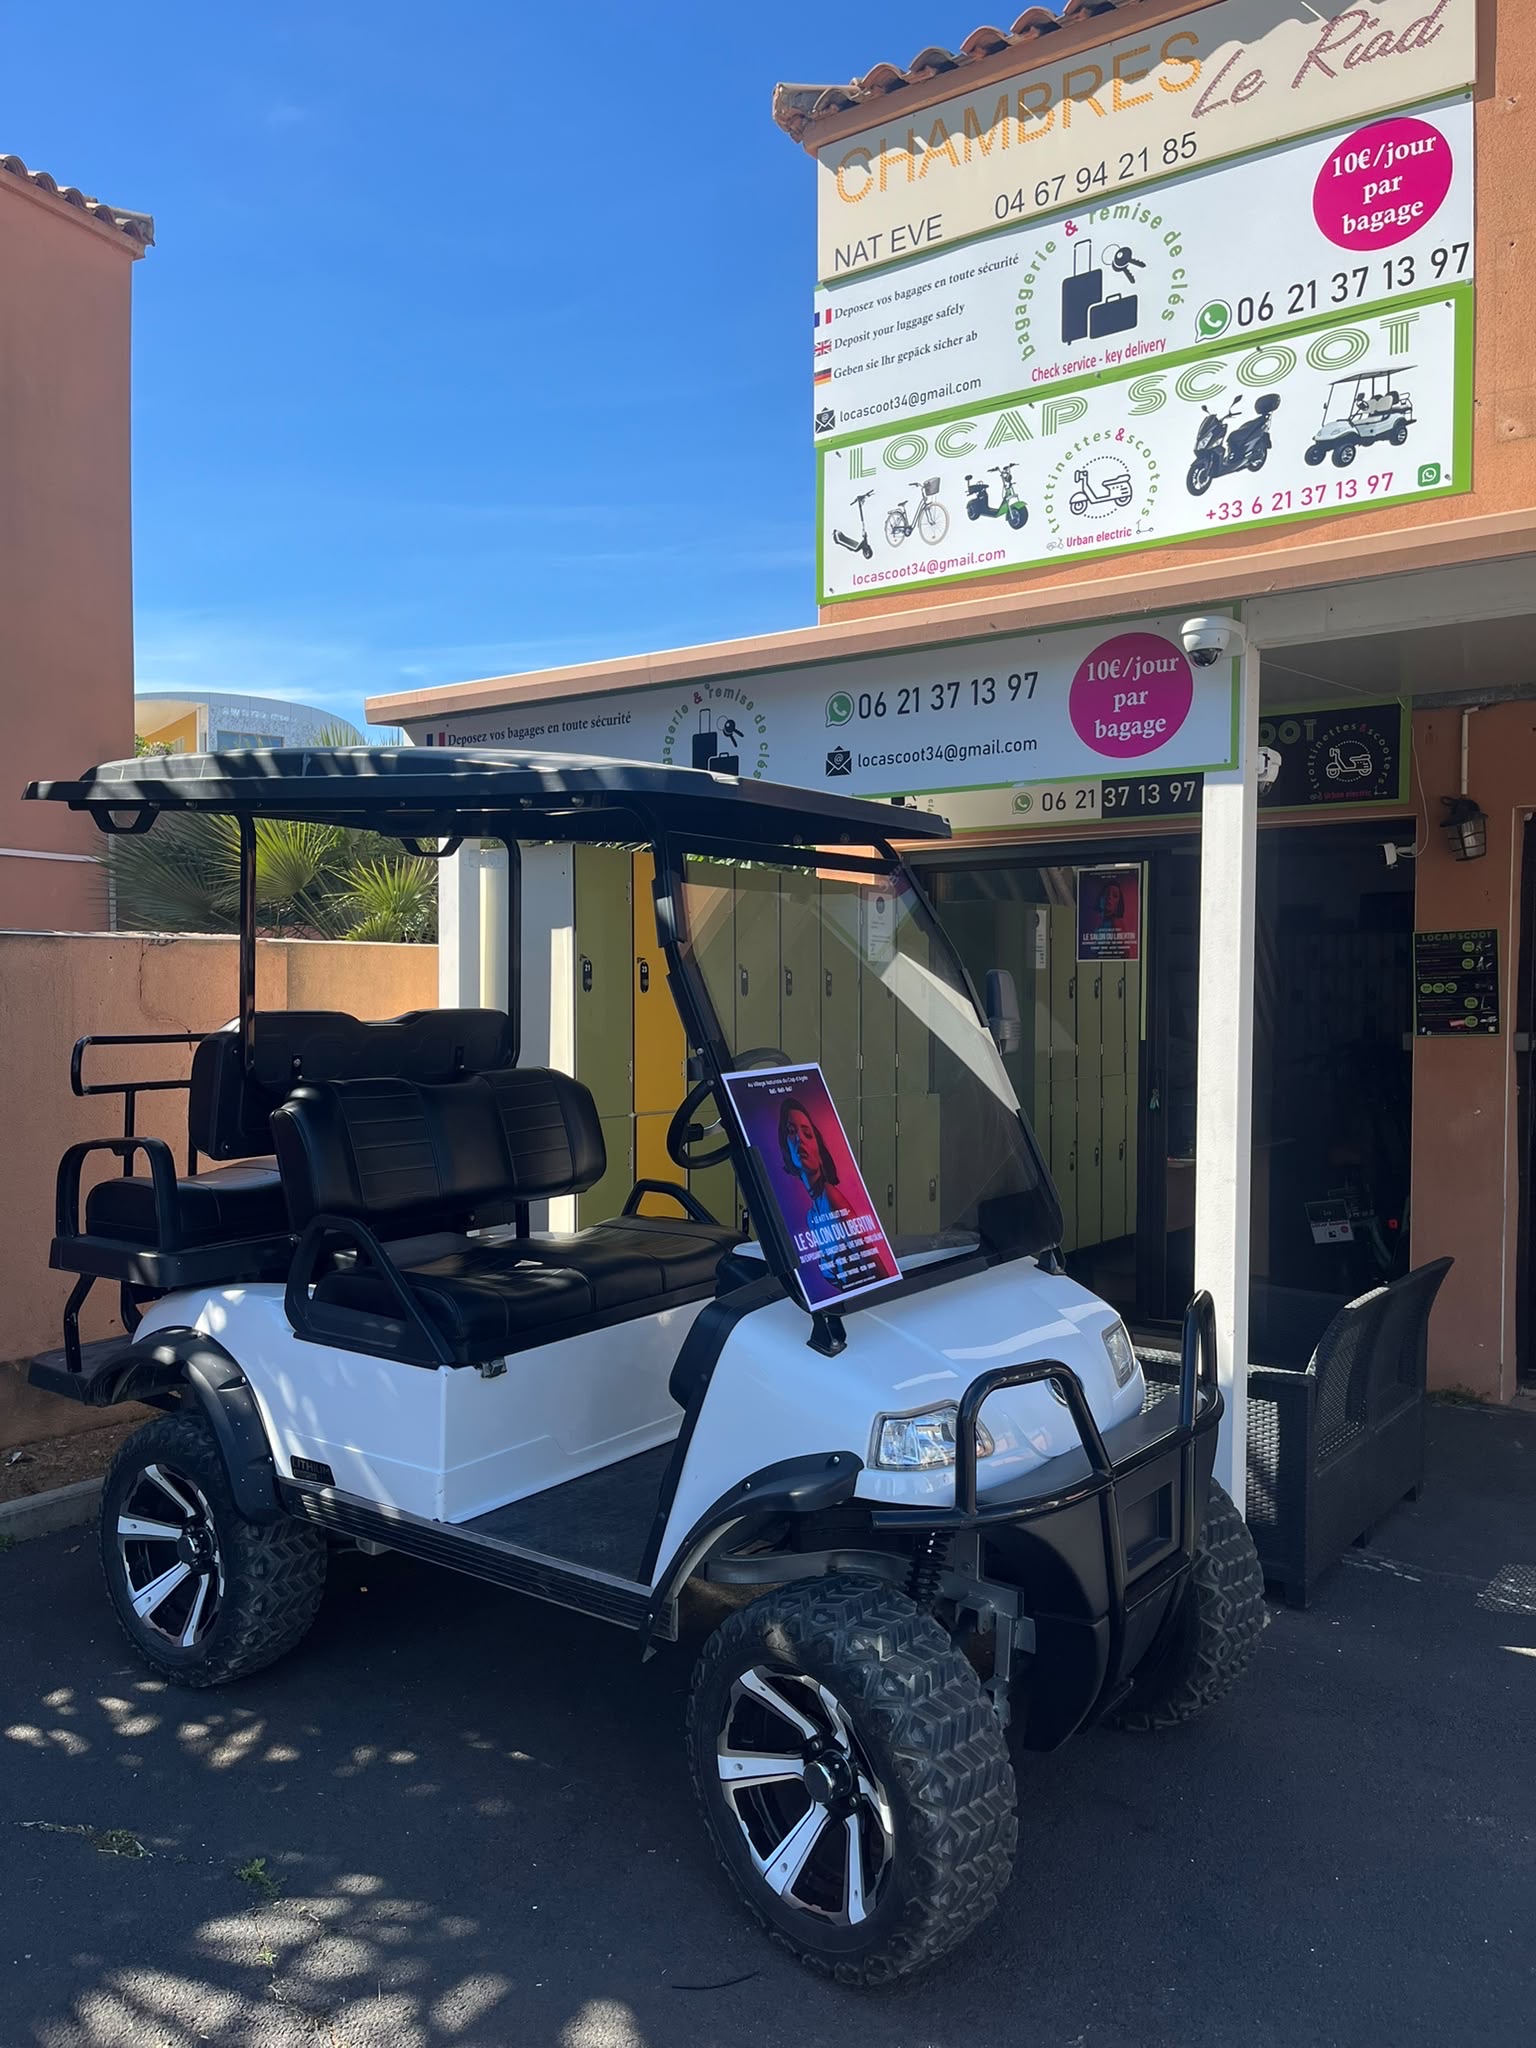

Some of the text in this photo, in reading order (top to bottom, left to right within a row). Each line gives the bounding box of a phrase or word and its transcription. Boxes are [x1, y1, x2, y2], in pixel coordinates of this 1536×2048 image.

[1191, 0, 1449, 119] Le Riad
[834, 31, 1202, 203] CHAMBRES
[994, 131, 1198, 219] 04 67 94 21 85
[1332, 134, 1437, 177] 10€/jour
[1362, 174, 1403, 204] par
[1342, 200, 1424, 235] bagage
[834, 215, 943, 271] NAT EVE
[834, 253, 1020, 320] Deposez vos bagages en toute sécurité
[1015, 203, 1188, 361] bagagerie & remise de clés
[1237, 241, 1470, 326] 06 21 37 13 97
[834, 301, 965, 350] Deposit your luggage safely
[833, 330, 979, 380] Geben sie Ihr gepäck sicher ab
[1031, 361, 1060, 382] Check
[1061, 355, 1097, 375] service
[1105, 347, 1123, 364] key
[1124, 337, 1167, 360] delivery
[839, 376, 982, 422] locascoot34@gmail.com
[850, 312, 1420, 480] LOCAP SCOOT
[1206, 472, 1394, 521] +33 6 21 37 13 97
[1066, 527, 1133, 547] Urban electric
[852, 548, 1006, 586] locascoot34@gmail.com
[1086, 653, 1180, 682] 10€/jour
[858, 671, 1039, 719] 06 21 37 13 97
[1113, 689, 1149, 713] par
[448, 711, 632, 748] Deposez vos bagages en toute sécurité
[662, 687, 770, 779] gagerie & remise de clés
[1094, 716, 1167, 741] bagage
[1259, 719, 1317, 746] OOT
[857, 737, 1038, 768] locascoot34@gmail.com
[1041, 780, 1197, 813] 06 21 37 13 97
[794, 1233, 808, 1252] LE
[806, 1226, 835, 1249] SALON
[832, 1223, 846, 1241] DU
[842, 1215, 876, 1237] LIBERTIN
